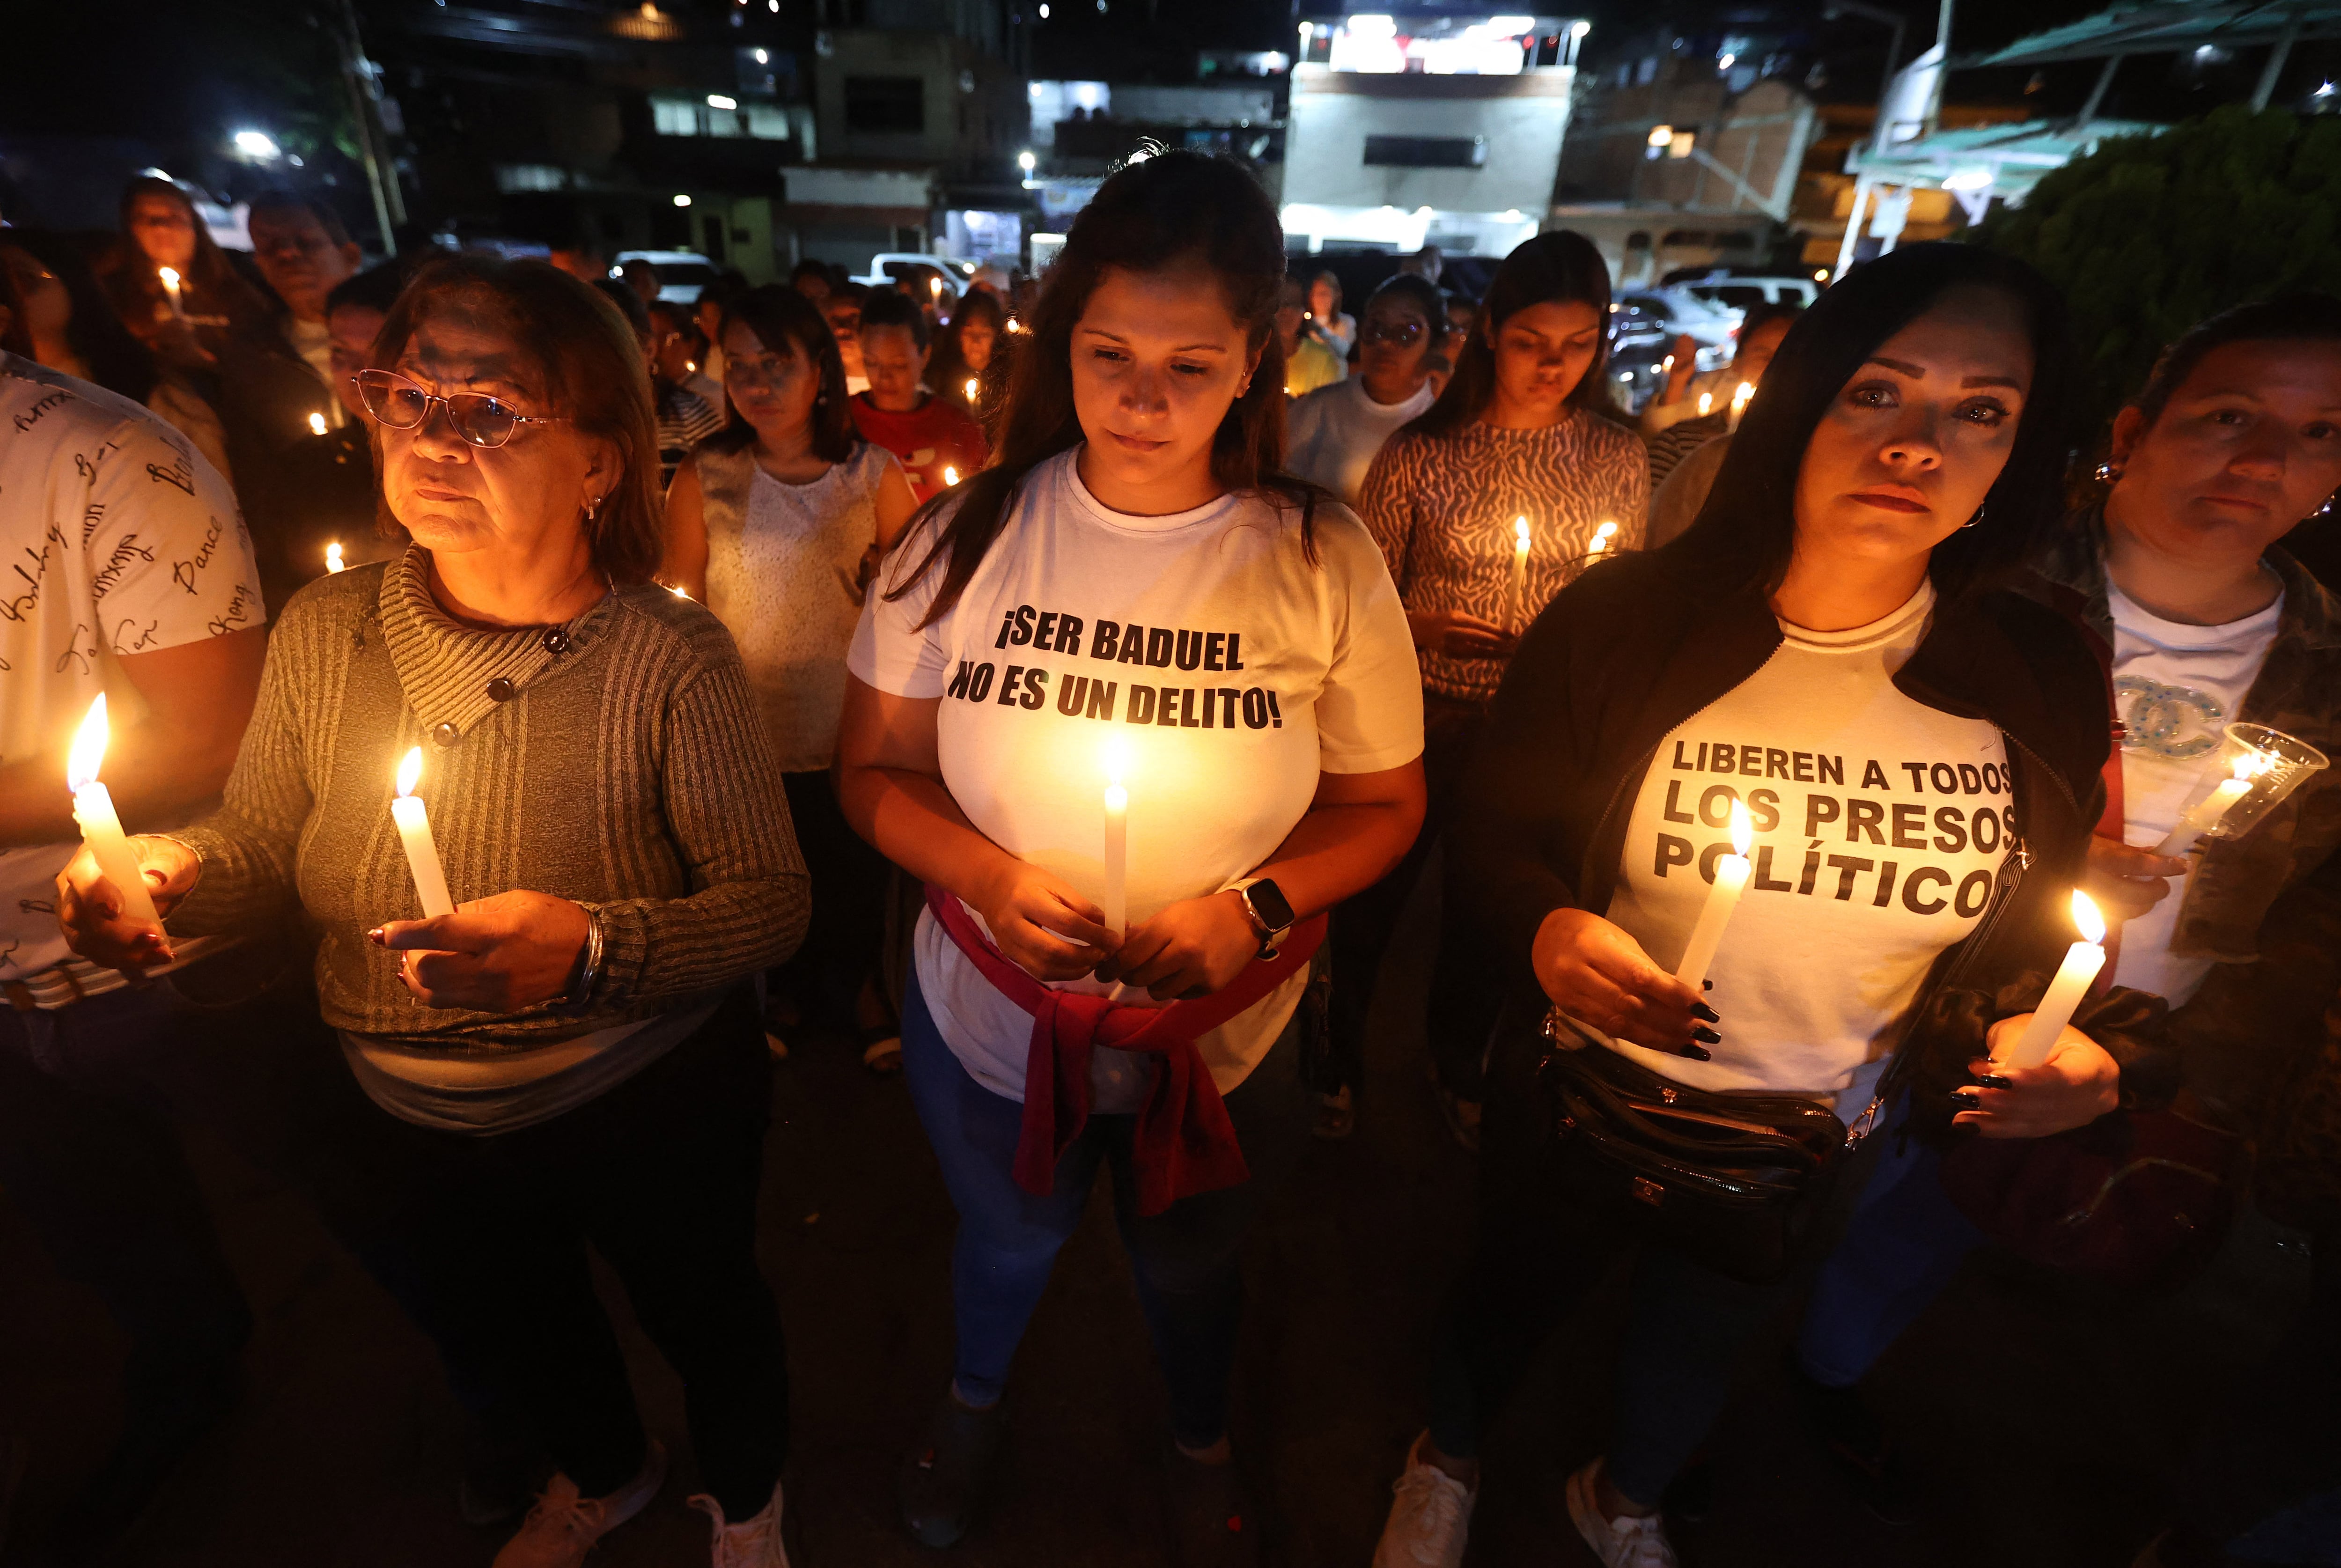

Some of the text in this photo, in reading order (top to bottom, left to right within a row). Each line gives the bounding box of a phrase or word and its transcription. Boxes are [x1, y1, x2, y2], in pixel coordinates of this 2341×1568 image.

[174, 515, 223, 595] Dance
[994, 604, 1244, 671] ¡SER BADUEL
[948, 661, 1282, 729] NO ES UN DELITO!
[1672, 740, 2012, 795] LIBEREN A TODOS
[1664, 780, 2015, 854] LOS PRESOS
